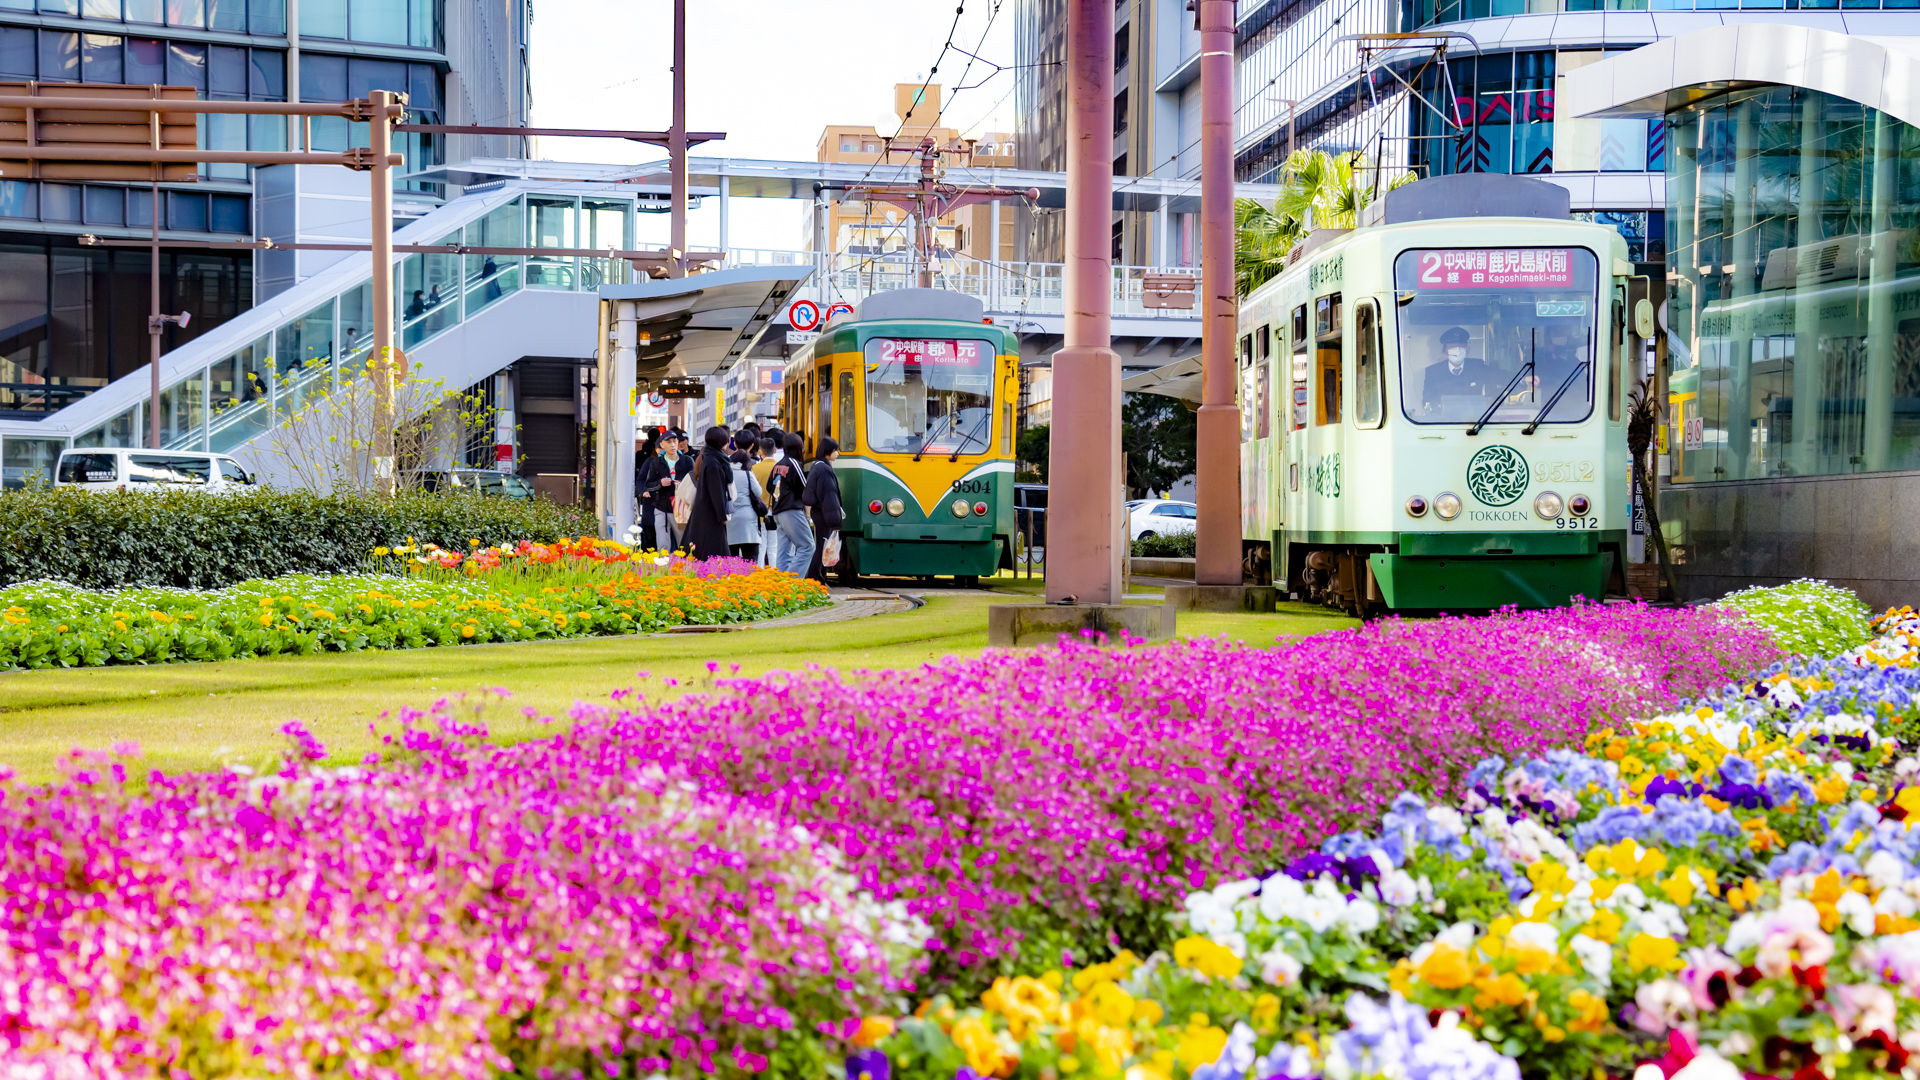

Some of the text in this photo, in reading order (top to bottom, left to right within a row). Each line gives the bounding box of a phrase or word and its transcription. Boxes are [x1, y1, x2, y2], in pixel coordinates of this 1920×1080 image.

[1421, 252, 1442, 283] 2
[1444, 250, 1568, 274] 中央駅前 鹿児島駅前
[1488, 273, 1567, 284] Kagoshimaeki-mae
[1538, 303, 1585, 315] ワンマン
[881, 340, 896, 361] 2
[896, 340, 976, 357] 中央駅前 郡元
[934, 356, 969, 364] Korimoto
[1534, 461, 1595, 483] 9512
[952, 480, 991, 494] 9504
[1468, 510, 1528, 522] TOKKOEN
[1556, 517, 1598, 529] 9512
